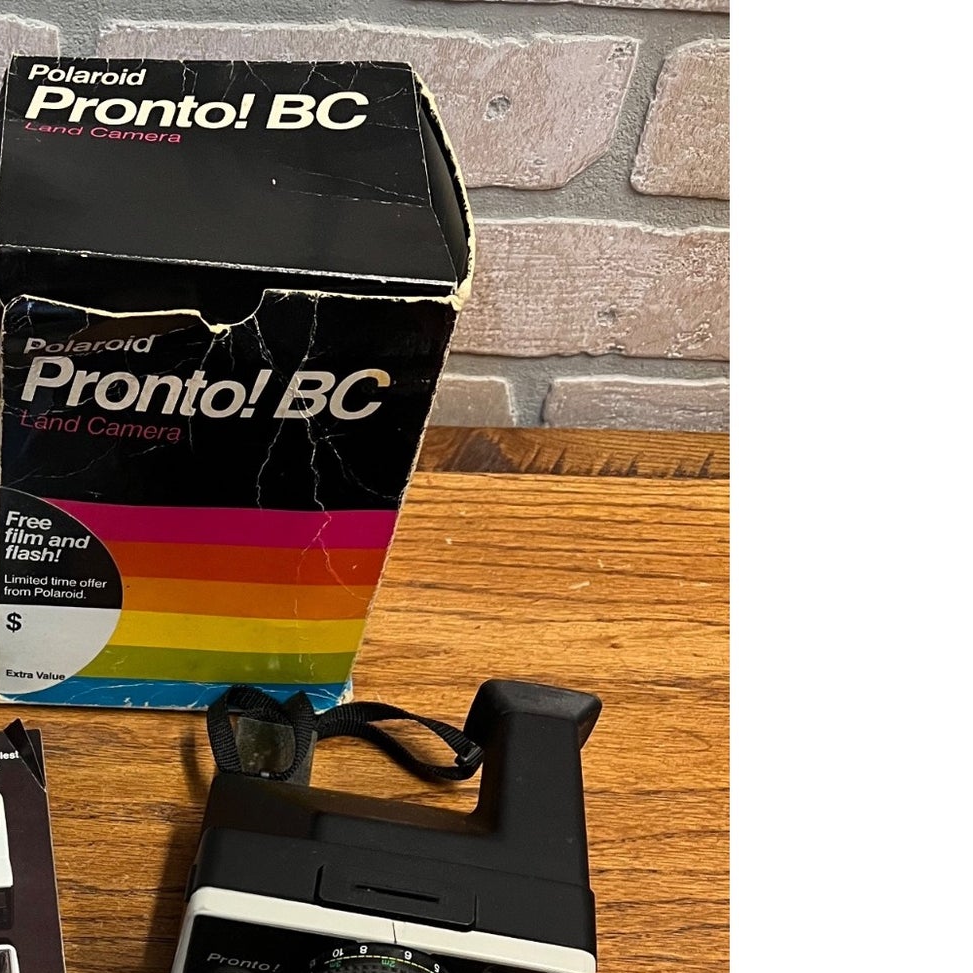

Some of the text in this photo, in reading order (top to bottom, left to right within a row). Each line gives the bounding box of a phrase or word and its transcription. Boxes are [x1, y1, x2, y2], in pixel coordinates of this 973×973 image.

[28, 64, 146, 86] Polaroid
[25, 85, 369, 130] Pronto! BC
[25, 122, 181, 144] Land Camera
[24, 334, 156, 354] Polaroid
[21, 356, 390, 421] Pronto! BC
[20, 410, 181, 441] Land Camera
[6, 511, 52, 530] Free
[5, 528, 90, 549] film and
[5, 545, 61, 562] flash!
[5, 575, 107, 588] Limited time offer
[4, 587, 86, 599] from Polaroid.
[6, 612, 22, 632] $
[6, 669, 65, 680] Extra Value
[333, 948, 344, 957] 10
[360, 945, 368, 954] 8
[207, 953, 280, 972] Pronto!
